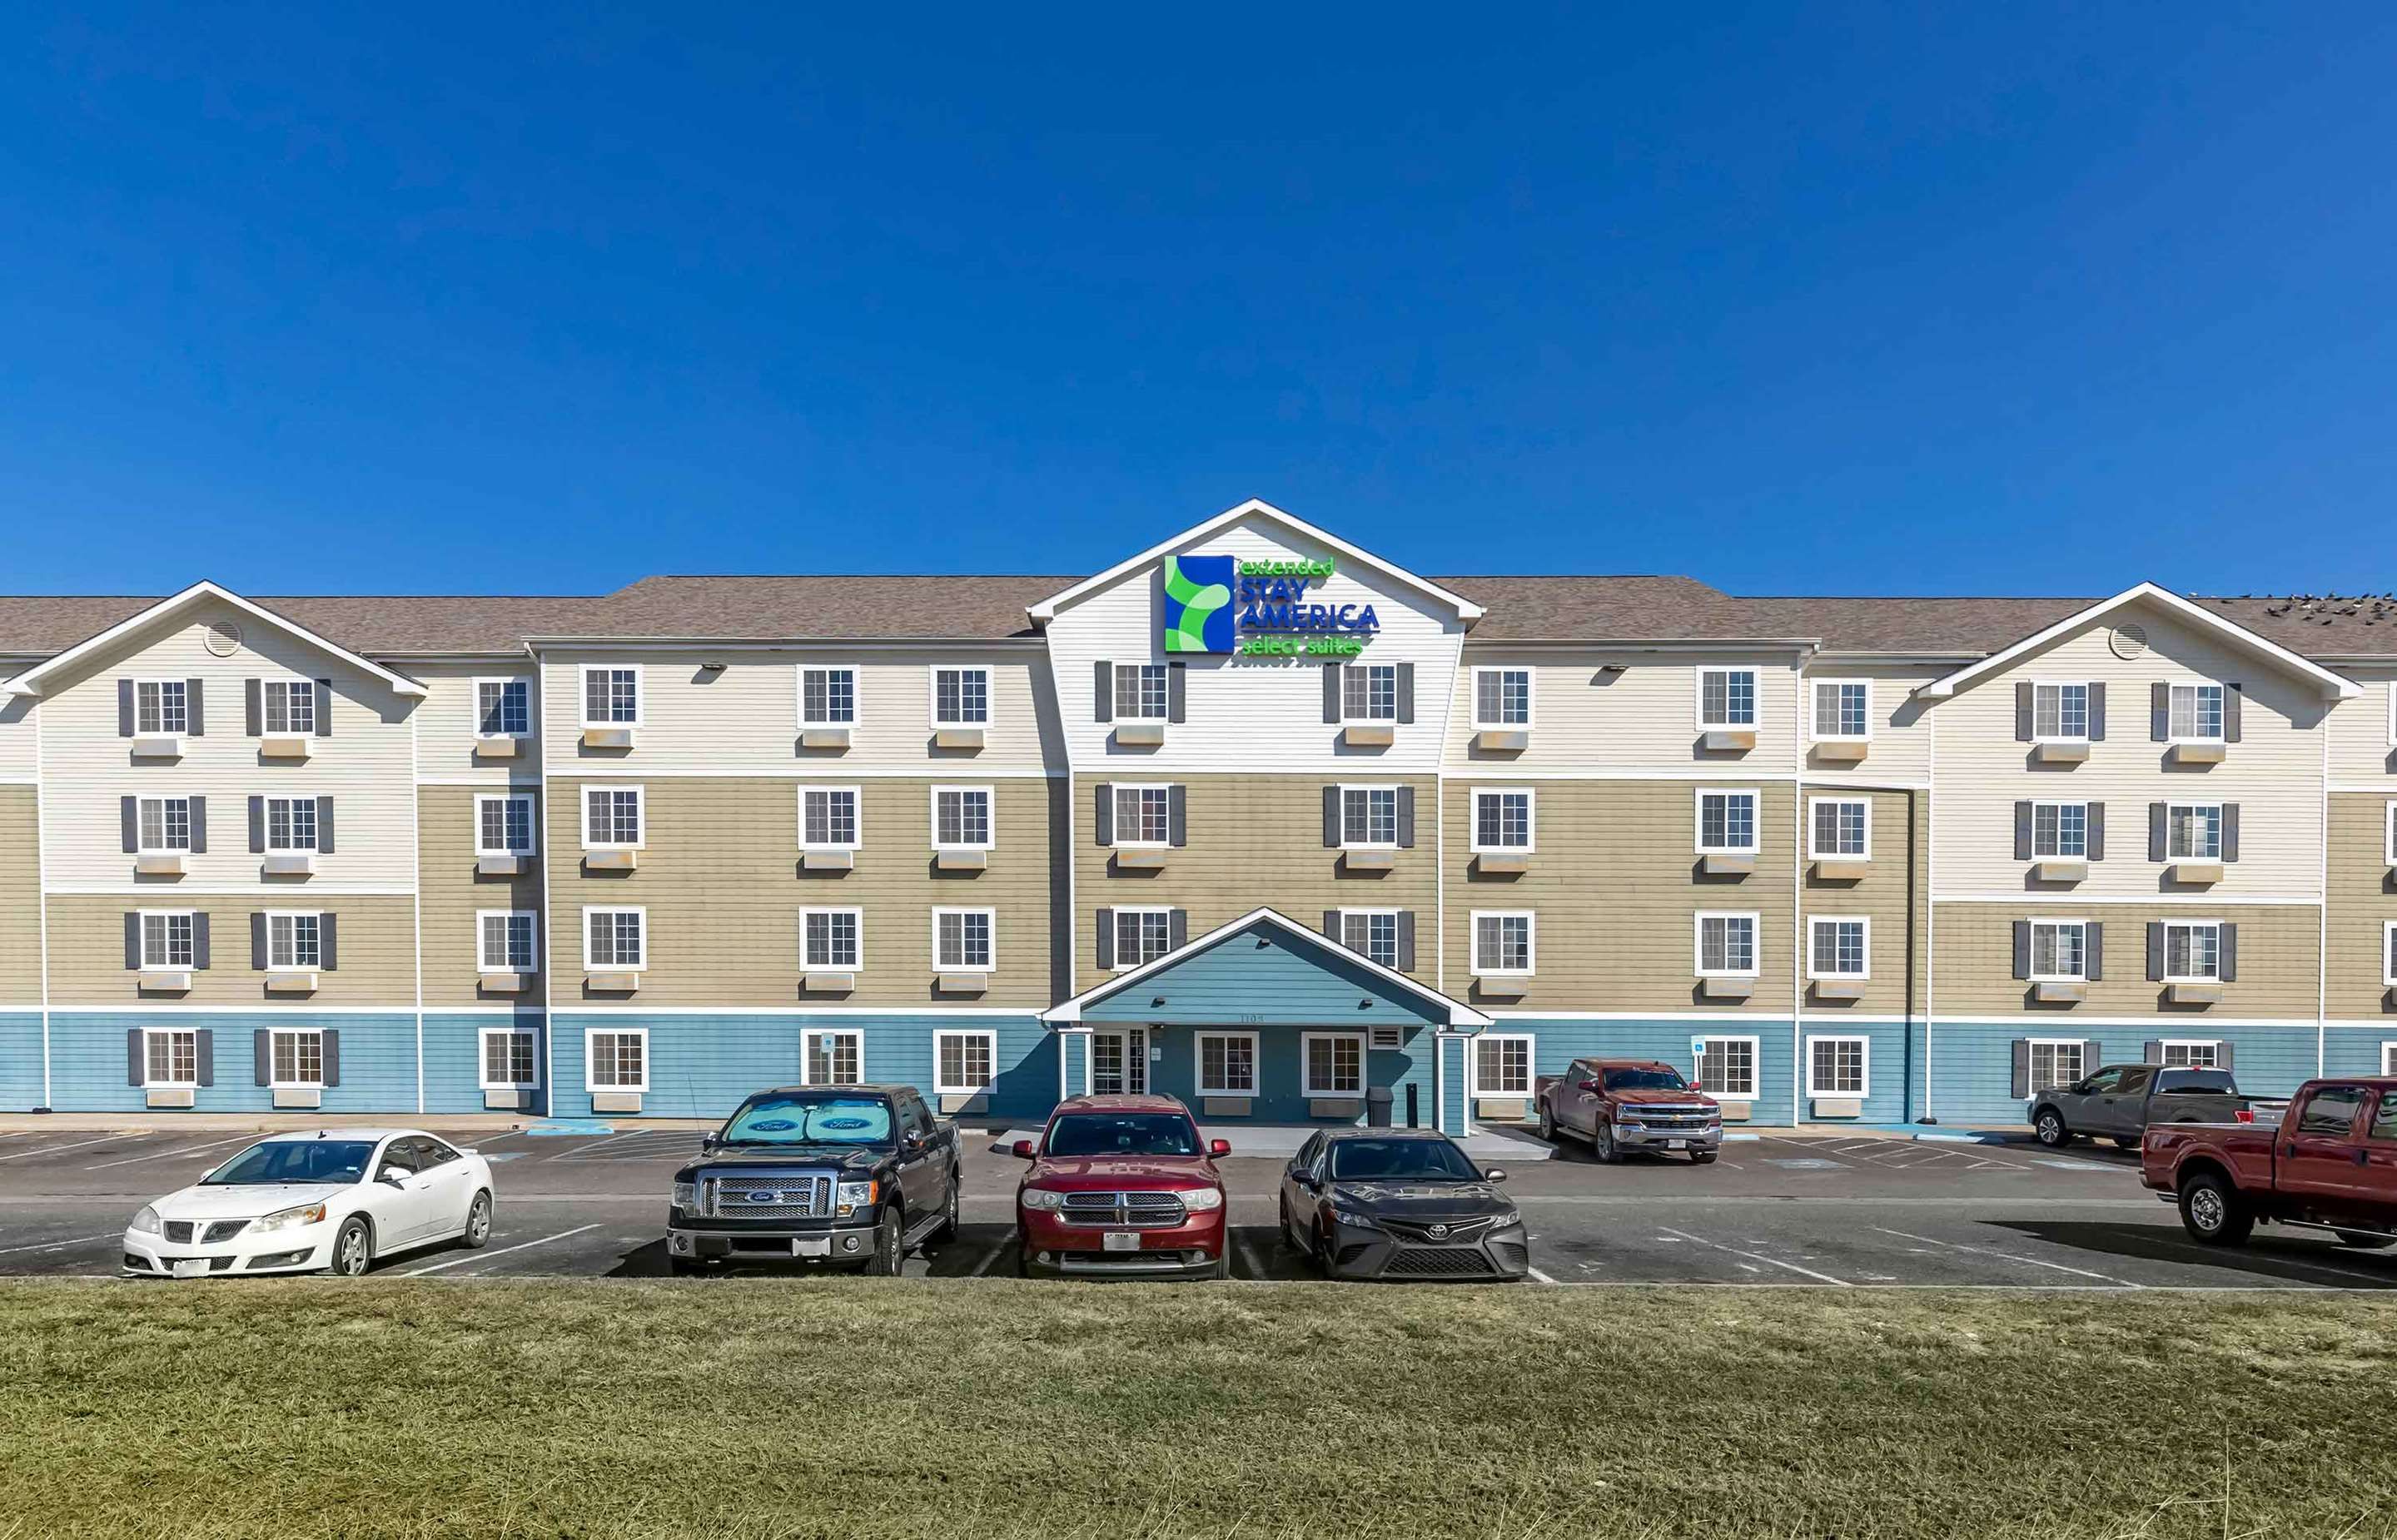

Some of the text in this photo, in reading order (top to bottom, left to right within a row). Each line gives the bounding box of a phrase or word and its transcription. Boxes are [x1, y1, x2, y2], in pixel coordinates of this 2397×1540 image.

[1240, 558, 1335, 575] extended
[1241, 578, 1310, 602] STAY
[1241, 604, 1380, 628] AMERICA
[1242, 635, 1363, 654] select suites
